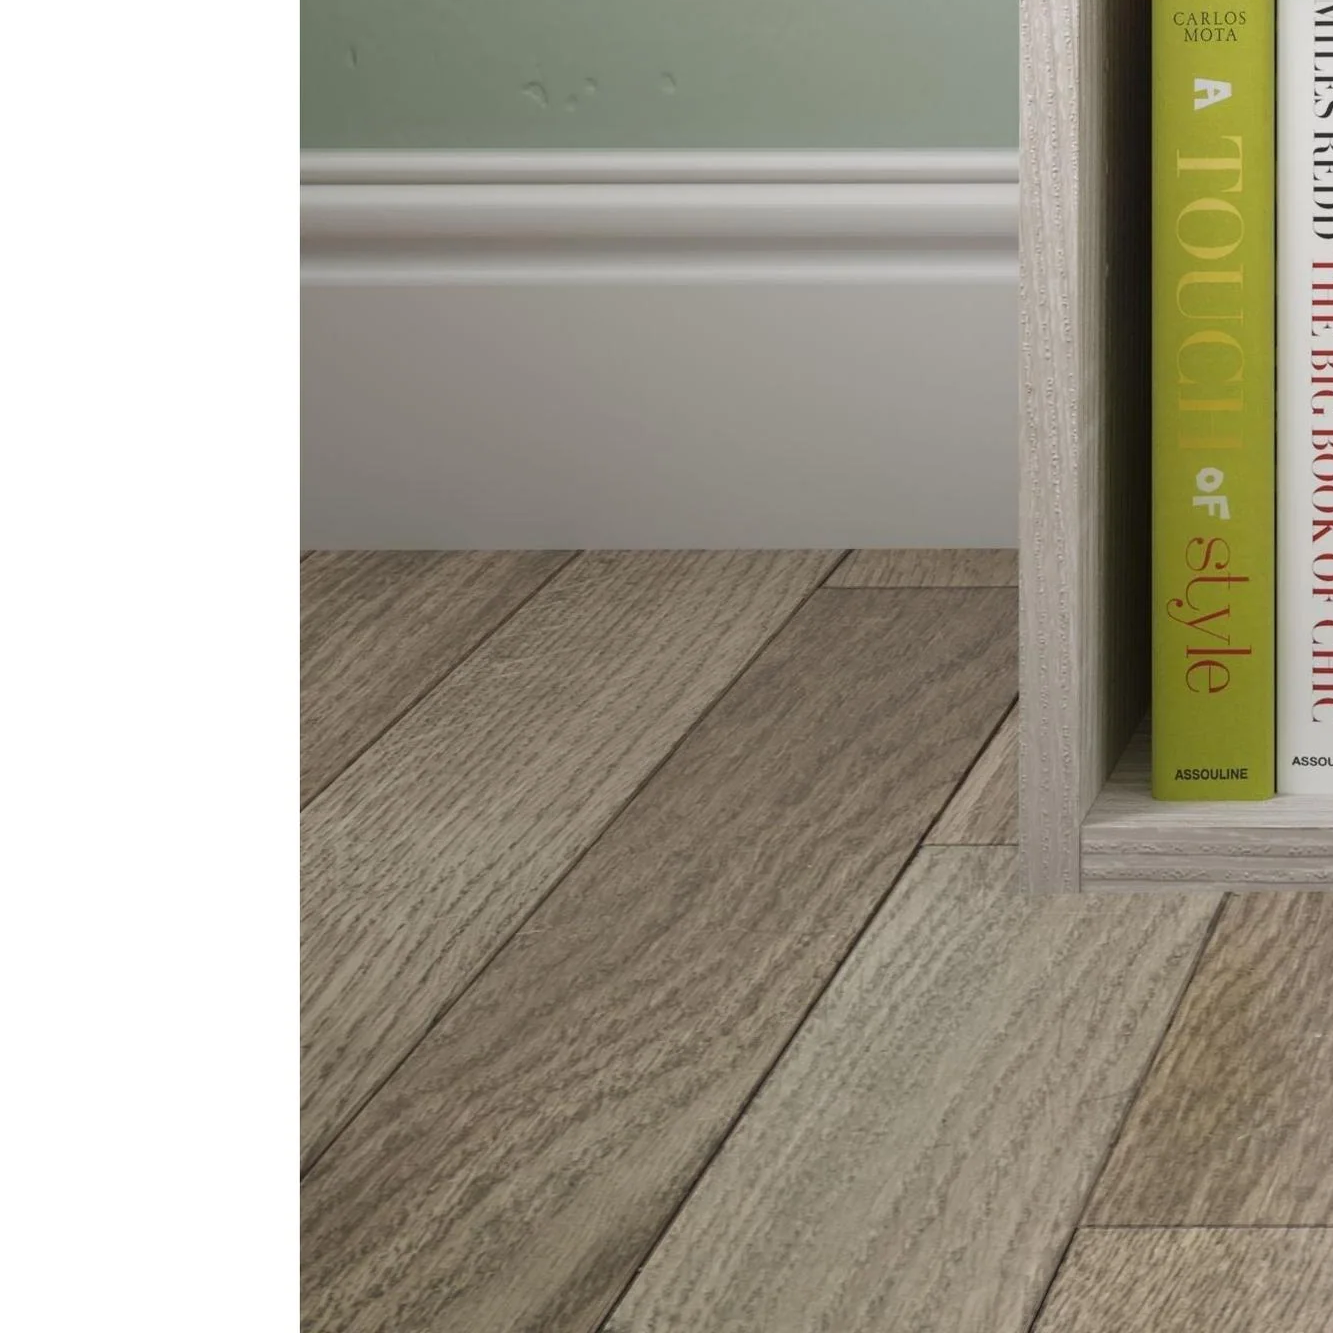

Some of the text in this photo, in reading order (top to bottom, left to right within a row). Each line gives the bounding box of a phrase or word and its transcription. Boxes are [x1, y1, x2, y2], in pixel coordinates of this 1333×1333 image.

[1173, 11, 1247, 26] CARLOS
[1184, 28, 1238, 42] MOTA
[1166, 77, 1252, 695] A TOUCH OF style
[1174, 767, 1248, 781] ASSOULINE
